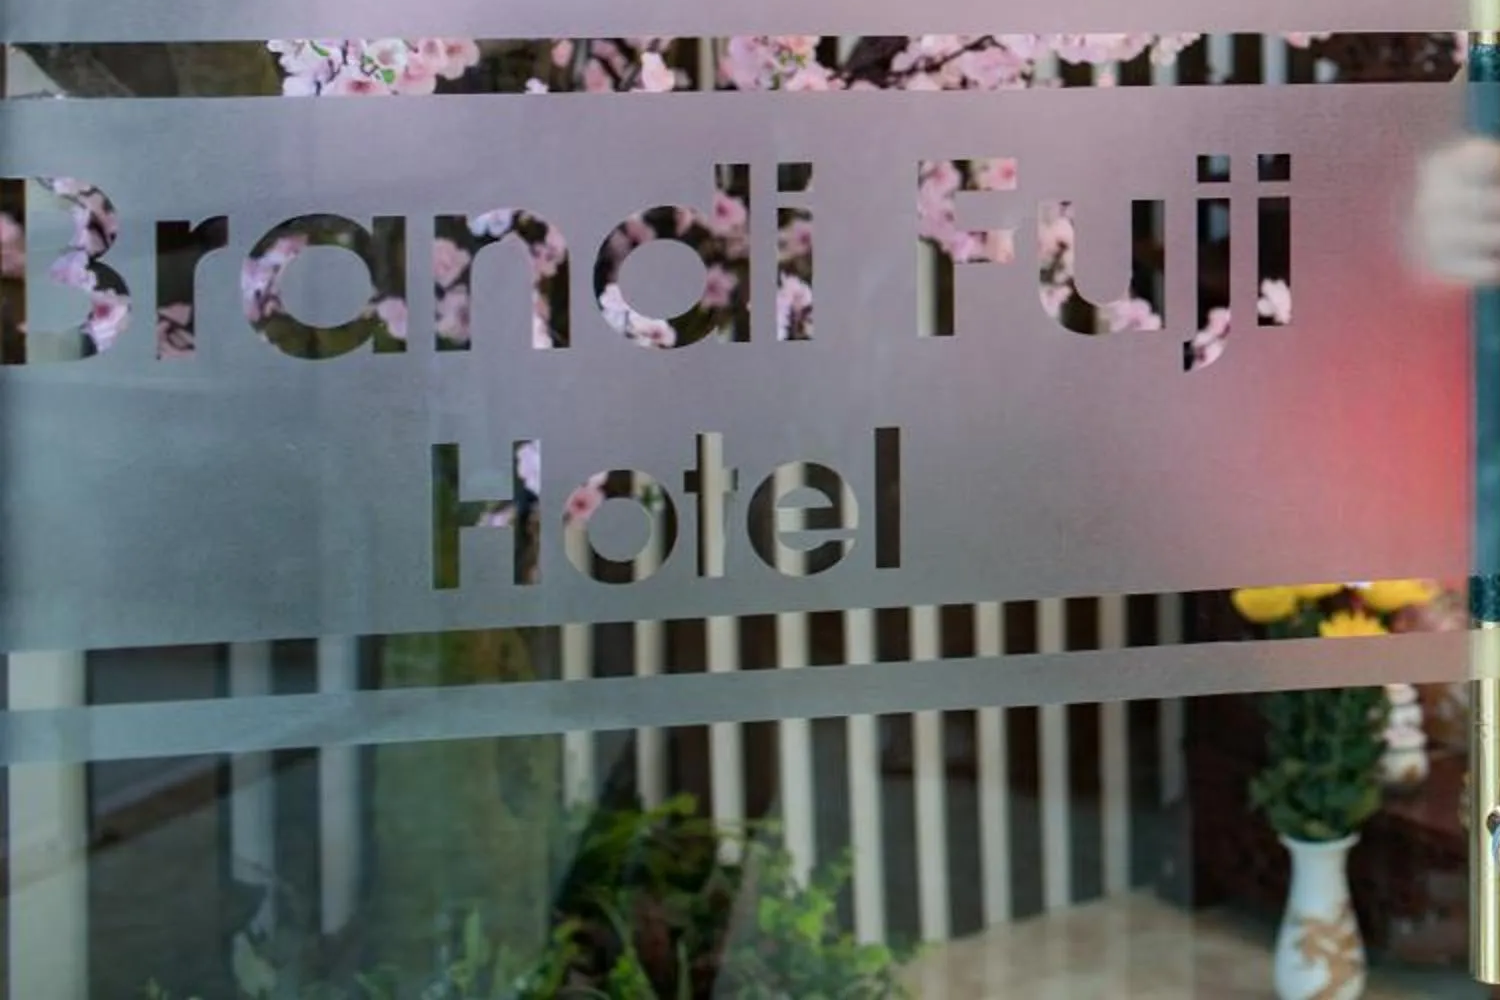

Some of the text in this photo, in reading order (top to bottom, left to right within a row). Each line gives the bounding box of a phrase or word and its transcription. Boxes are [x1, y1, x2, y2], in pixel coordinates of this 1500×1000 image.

[0, 153, 1291, 372] Brandi Fuji
[430, 426, 901, 590] Hotel
